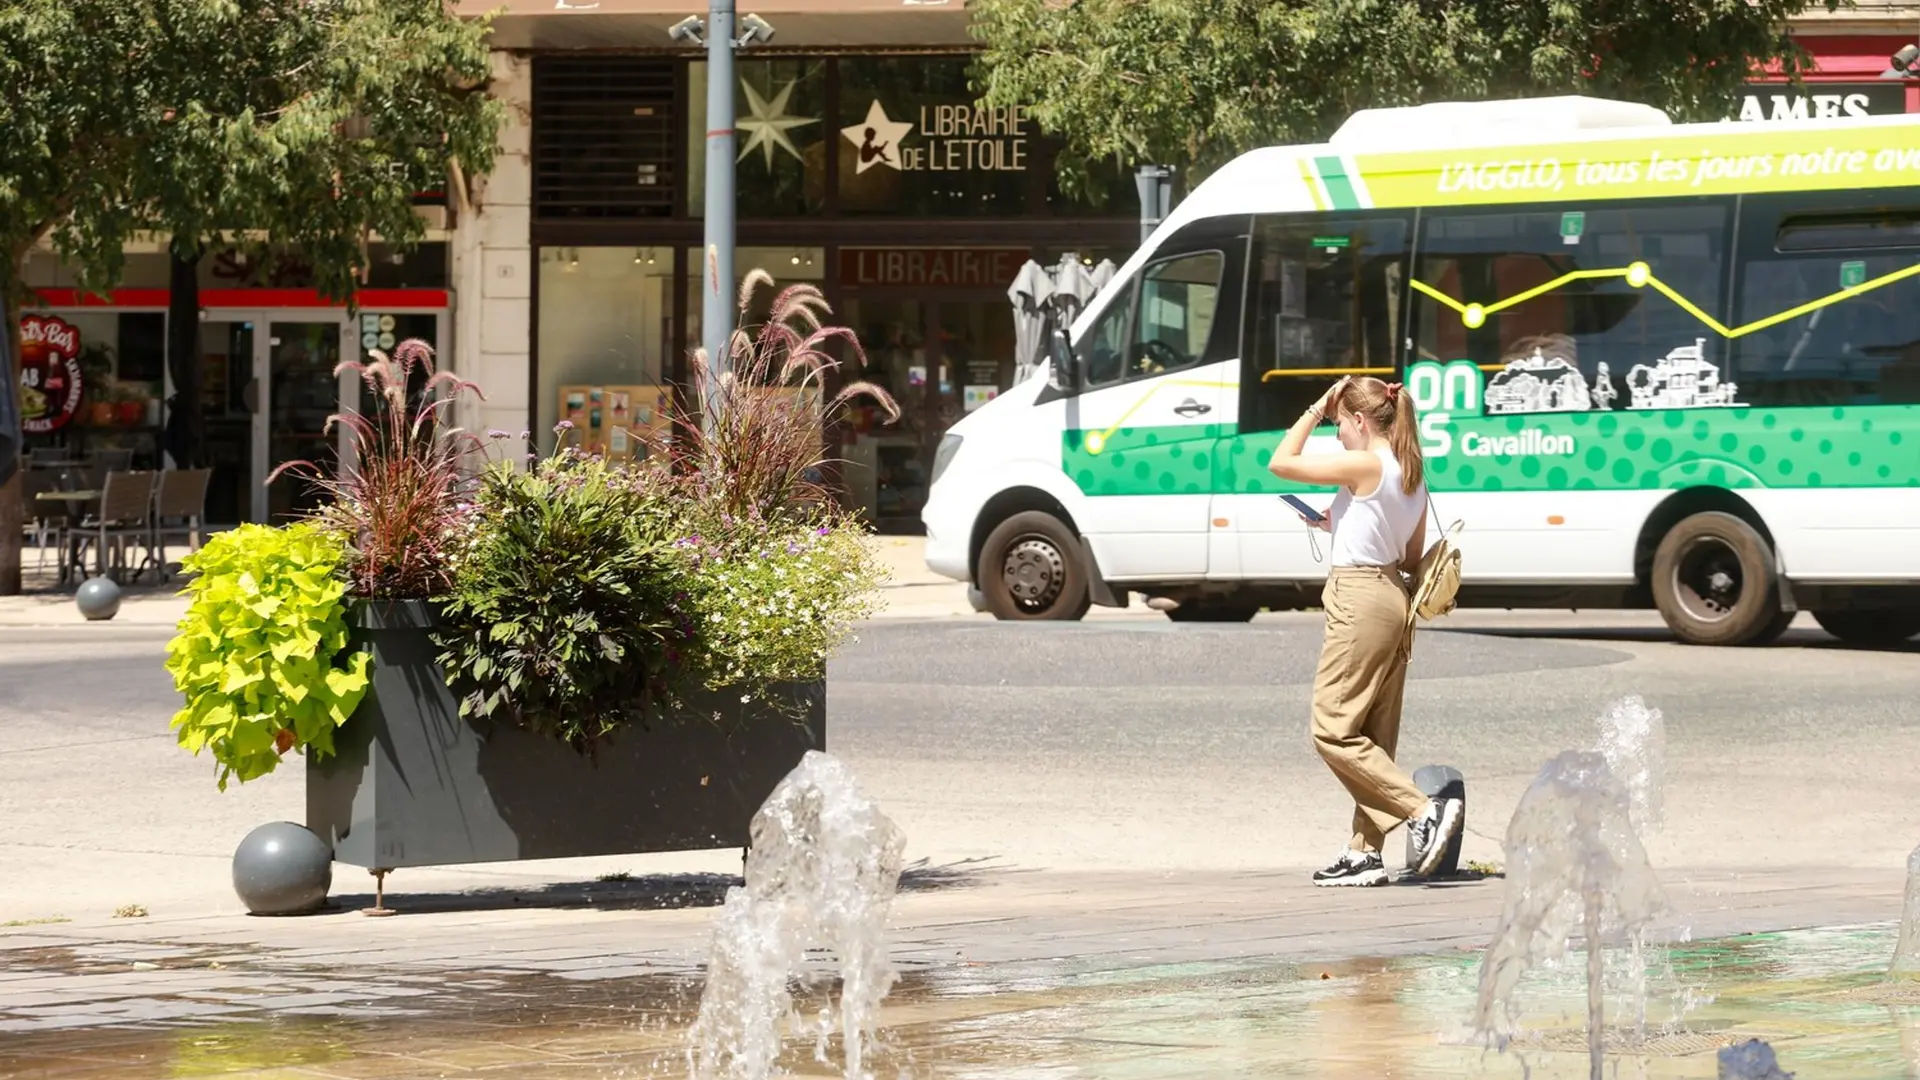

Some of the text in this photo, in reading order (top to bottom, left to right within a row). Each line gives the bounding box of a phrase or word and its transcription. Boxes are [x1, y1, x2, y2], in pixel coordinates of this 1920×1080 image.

[921, 105, 1027, 136] LIBRAIRIE
[903, 139, 1027, 170] DE L'ETOILE
[1575, 158, 1640, 186] tous
[1646, 151, 1688, 183] les
[1690, 150, 1774, 187] jours
[1780, 147, 1867, 176] notre
[858, 251, 1010, 284] LIBRAIRIE
[1461, 429, 1574, 456] Cavaillon
